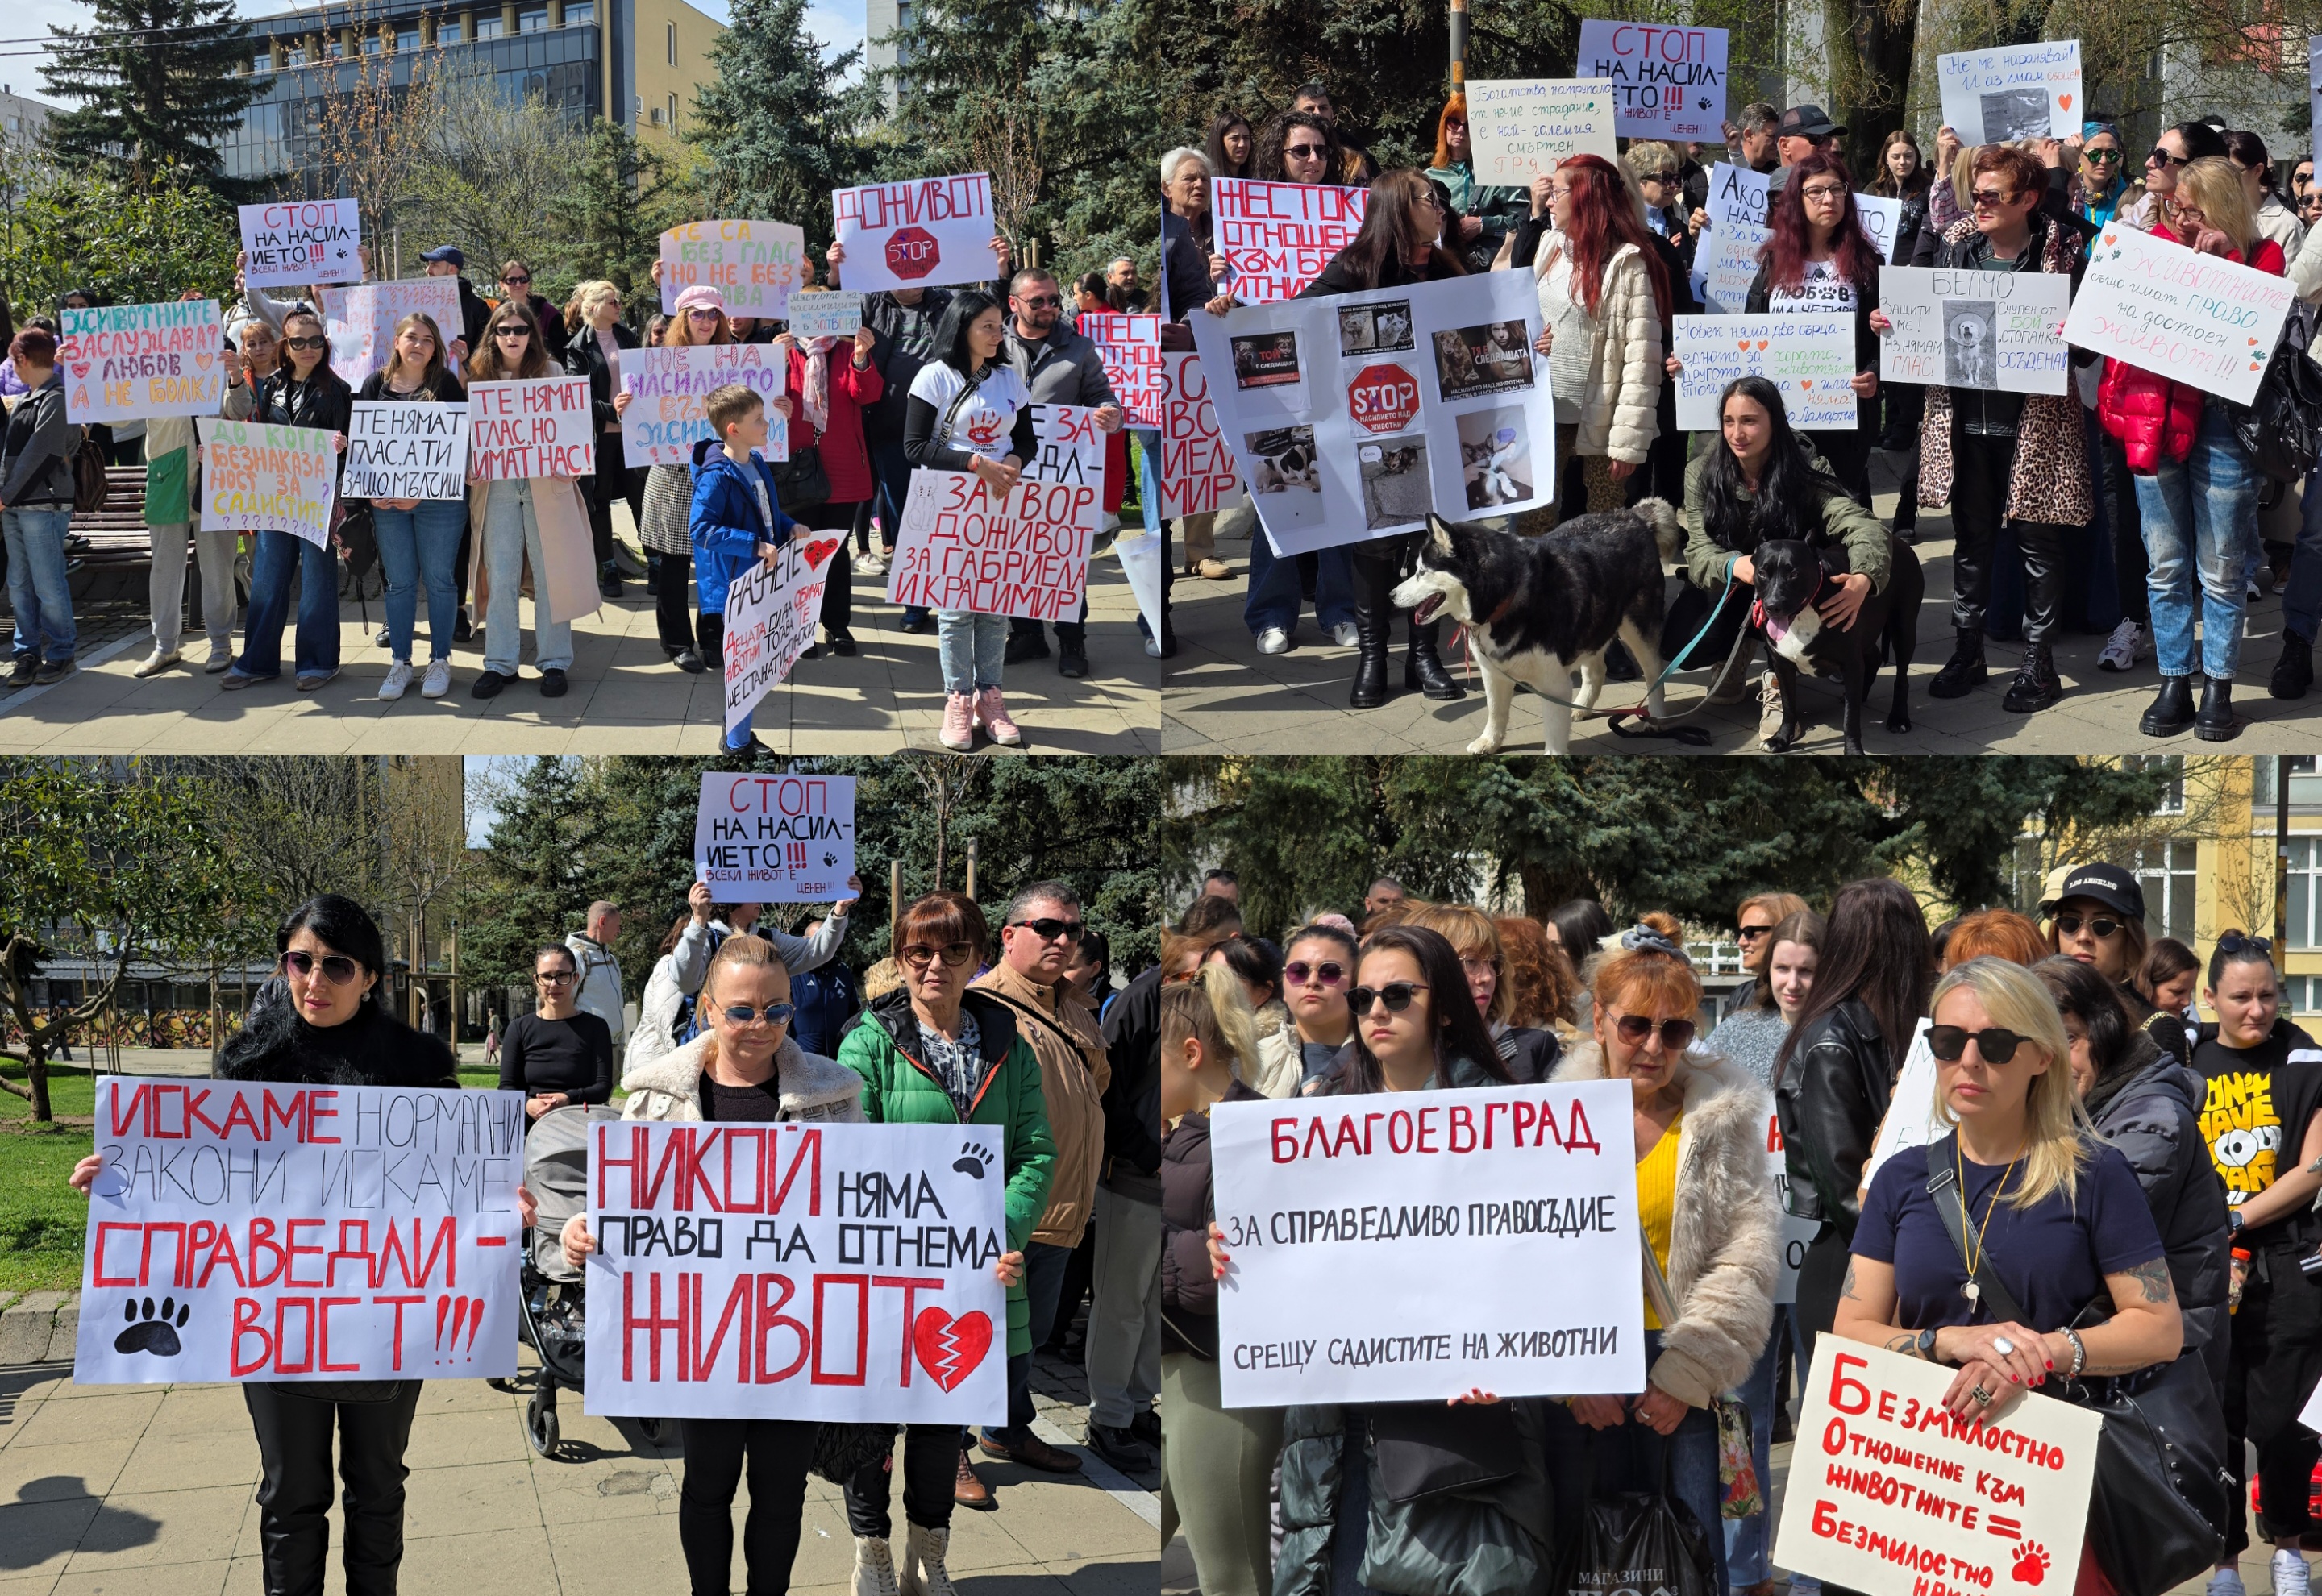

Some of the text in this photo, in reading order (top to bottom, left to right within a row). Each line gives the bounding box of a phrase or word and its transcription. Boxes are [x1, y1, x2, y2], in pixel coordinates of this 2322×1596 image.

[1612, 26, 1705, 63] СТОП
[1596, 60, 1725, 85] НА НАСИЛ-
[1625, 108, 1660, 118] ЖИВОТ
[1665, 111, 1671, 120] Е
[264, 204, 337, 228] СТОП
[837, 175, 988, 233] ДОЖИВОТ
[255, 226, 357, 247] НА НАСИЛ-
[668, 222, 751, 242] ТЕ СА
[681, 242, 797, 264] БЕЗ ГЛАС
[889, 241, 932, 262] STOP
[1226, 248, 1287, 273] КЪМ
[252, 264, 277, 274] ВСЕКИ
[282, 262, 308, 272] ЖИВОТ
[671, 263, 792, 285] НО НЕ БЕЗ
[1933, 272, 2014, 298] БЕЛЧО
[63, 301, 212, 335] ЖИВОТНИТЕ
[2011, 315, 2041, 329] БОЙ
[2187, 294, 2258, 329] ПРАВО
[65, 324, 218, 360] ЗАСЛУЖАВАТ
[1475, 348, 1528, 364] СЛЕДВАЩАТА
[102, 354, 181, 381] ЛЮБОВ
[645, 345, 762, 373] НЕ НА
[71, 375, 218, 409] А НЕ БОЛКА
[472, 382, 589, 414] ТЕ НЯМАТ
[1354, 383, 1413, 414] STOP
[352, 409, 466, 435] ТЕ НЯМАТ
[1360, 410, 1411, 422] НАСИЛИЕТО НАД
[1371, 422, 1401, 430] ЖИВОТНИ
[210, 421, 327, 455] ДО КОГА
[532, 418, 556, 443] НО
[405, 442, 418, 465] А
[422, 441, 452, 467] ТИ
[473, 443, 592, 478] ИМАТ НАС!
[210, 470, 301, 497] НОСТ ЗА
[343, 471, 461, 499] ЗАЩО МЪЛЧИШ
[929, 513, 1093, 558] ДОЖИВОТ
[903, 547, 1085, 592] ЗА ГАБРИЕЛА
[895, 572, 1076, 620] И КРАСИМИР
[730, 778, 826, 816] СТОП
[714, 815, 851, 840] НА НАСИЛ-
[706, 869, 796, 881] ВСЕКИ ЖИВОТ Е
[2069, 878, 2117, 890] LOS ANGELES
[111, 1083, 522, 1155] ИСКАМЕ НОРМАЛНИ
[1271, 1099, 1601, 1164] БЛАГОЕВГРАД
[101, 1144, 511, 1215] ЗАКОНИ ИСКАМЕ
[598, 1125, 947, 1220] НИКОЙ НЯМА
[1230, 1196, 1616, 1247] ЗА СПРАВЕДЛИВО ПРАВОСЪДИЕ
[597, 1216, 1002, 1269] ПРАВО ДА ОТНЕМА
[231, 1294, 485, 1377] ВОСТ!!!
[622, 1272, 944, 1387] ЖИВОТ
[1234, 1326, 1617, 1373] СРЕЩУ САДИСТИТЕ НА ЖИВОТНИ
[1976, 1471, 2024, 1507] КЪМ
[1579, 1569, 1663, 1584] МАГАЗИНИ
